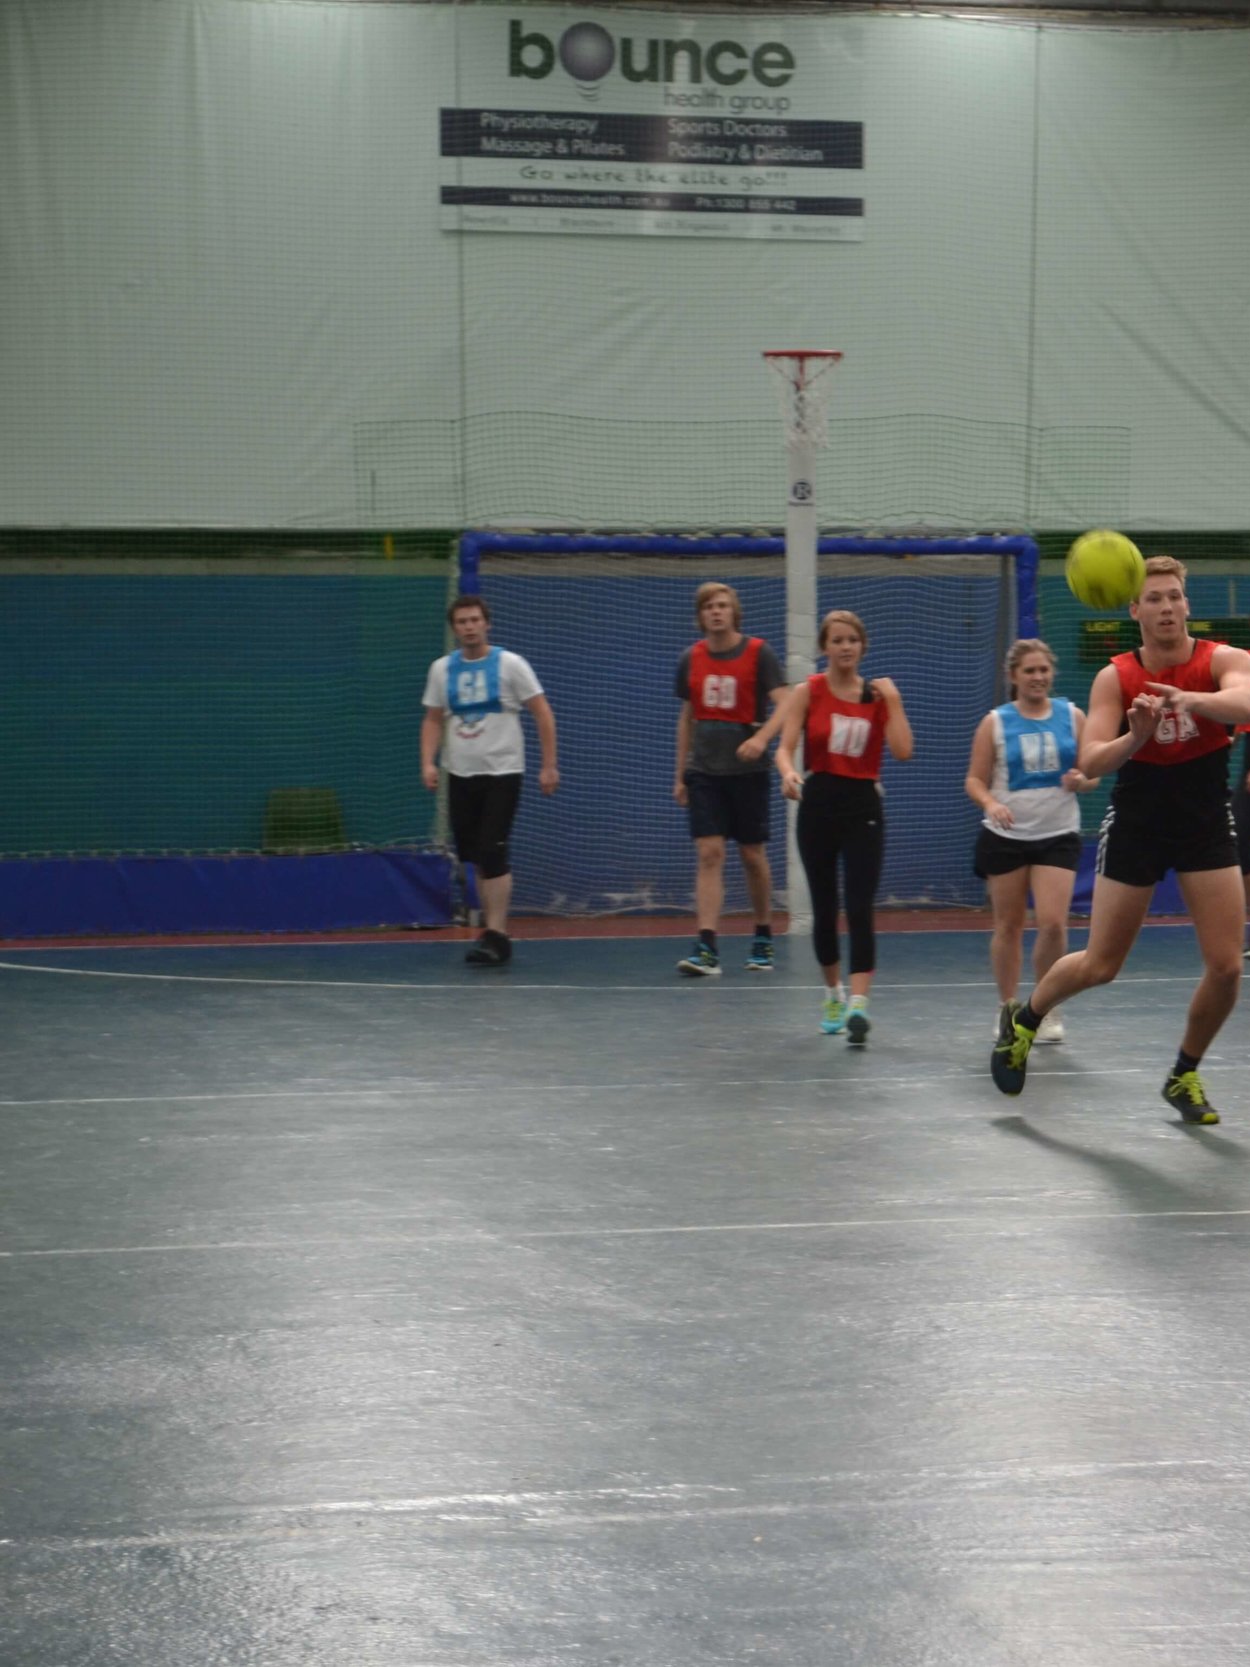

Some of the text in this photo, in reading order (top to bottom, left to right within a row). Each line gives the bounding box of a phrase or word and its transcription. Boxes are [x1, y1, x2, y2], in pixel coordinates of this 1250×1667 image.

[508, 19, 795, 87] bounce
[664, 86, 790, 114] health group
[480, 112, 599, 134] Physiotherapy
[667, 118, 788, 137] Sports Doctors
[480, 136, 625, 156] Massage & Pilates
[668, 142, 735, 161] Podiatry
[738, 144, 751, 160] &
[519, 165, 554, 181] Go
[564, 167, 625, 182] where
[635, 168, 668, 183] the
[680, 170, 728, 186] elite
[703, 674, 737, 709] GD
[1155, 707, 1199, 744] GA
